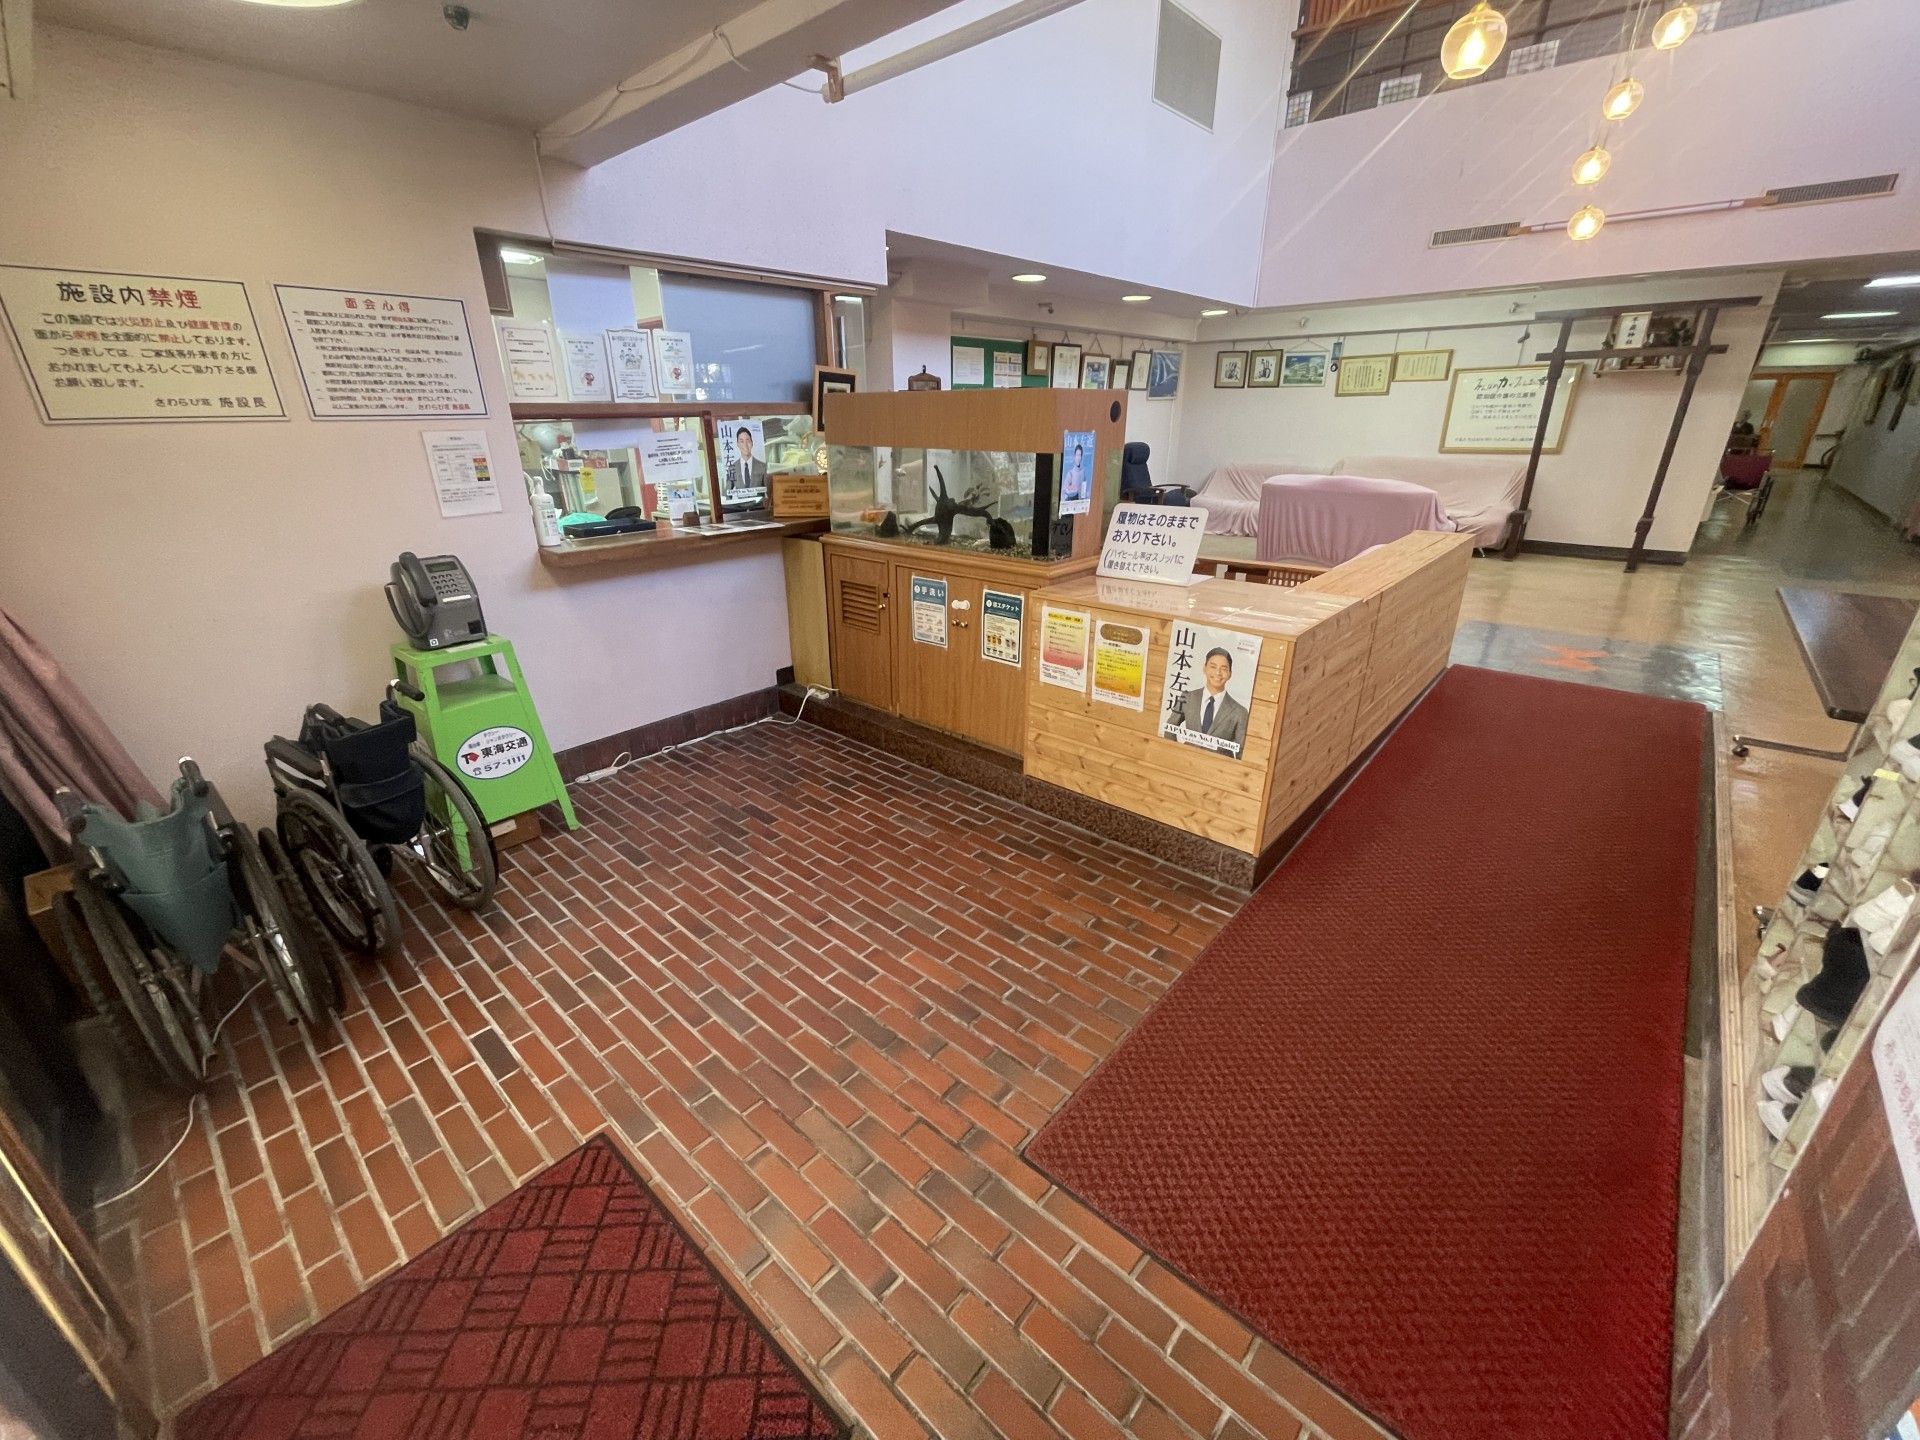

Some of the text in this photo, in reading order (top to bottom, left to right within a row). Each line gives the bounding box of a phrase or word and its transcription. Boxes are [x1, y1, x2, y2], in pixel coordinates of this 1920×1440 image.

[57, 281, 202, 309] 施設内禁煙
[344, 297, 412, 314] 面会心得
[54, 377, 144, 389] お願い致します。
[219, 396, 268, 409] 施設長
[721, 424, 738, 489] 山本左近
[1116, 511, 1199, 530] 履物はそのままで
[1112, 529, 1177, 548] お入り下さい。
[921, 586, 945, 597] 手洗い
[1166, 627, 1196, 717] 山本左近
[1164, 724, 1187, 736] JAPAN
[1199, 734, 1213, 743] No.1
[481, 736, 528, 758] 東海交通
[484, 754, 526, 772] 57-1111
